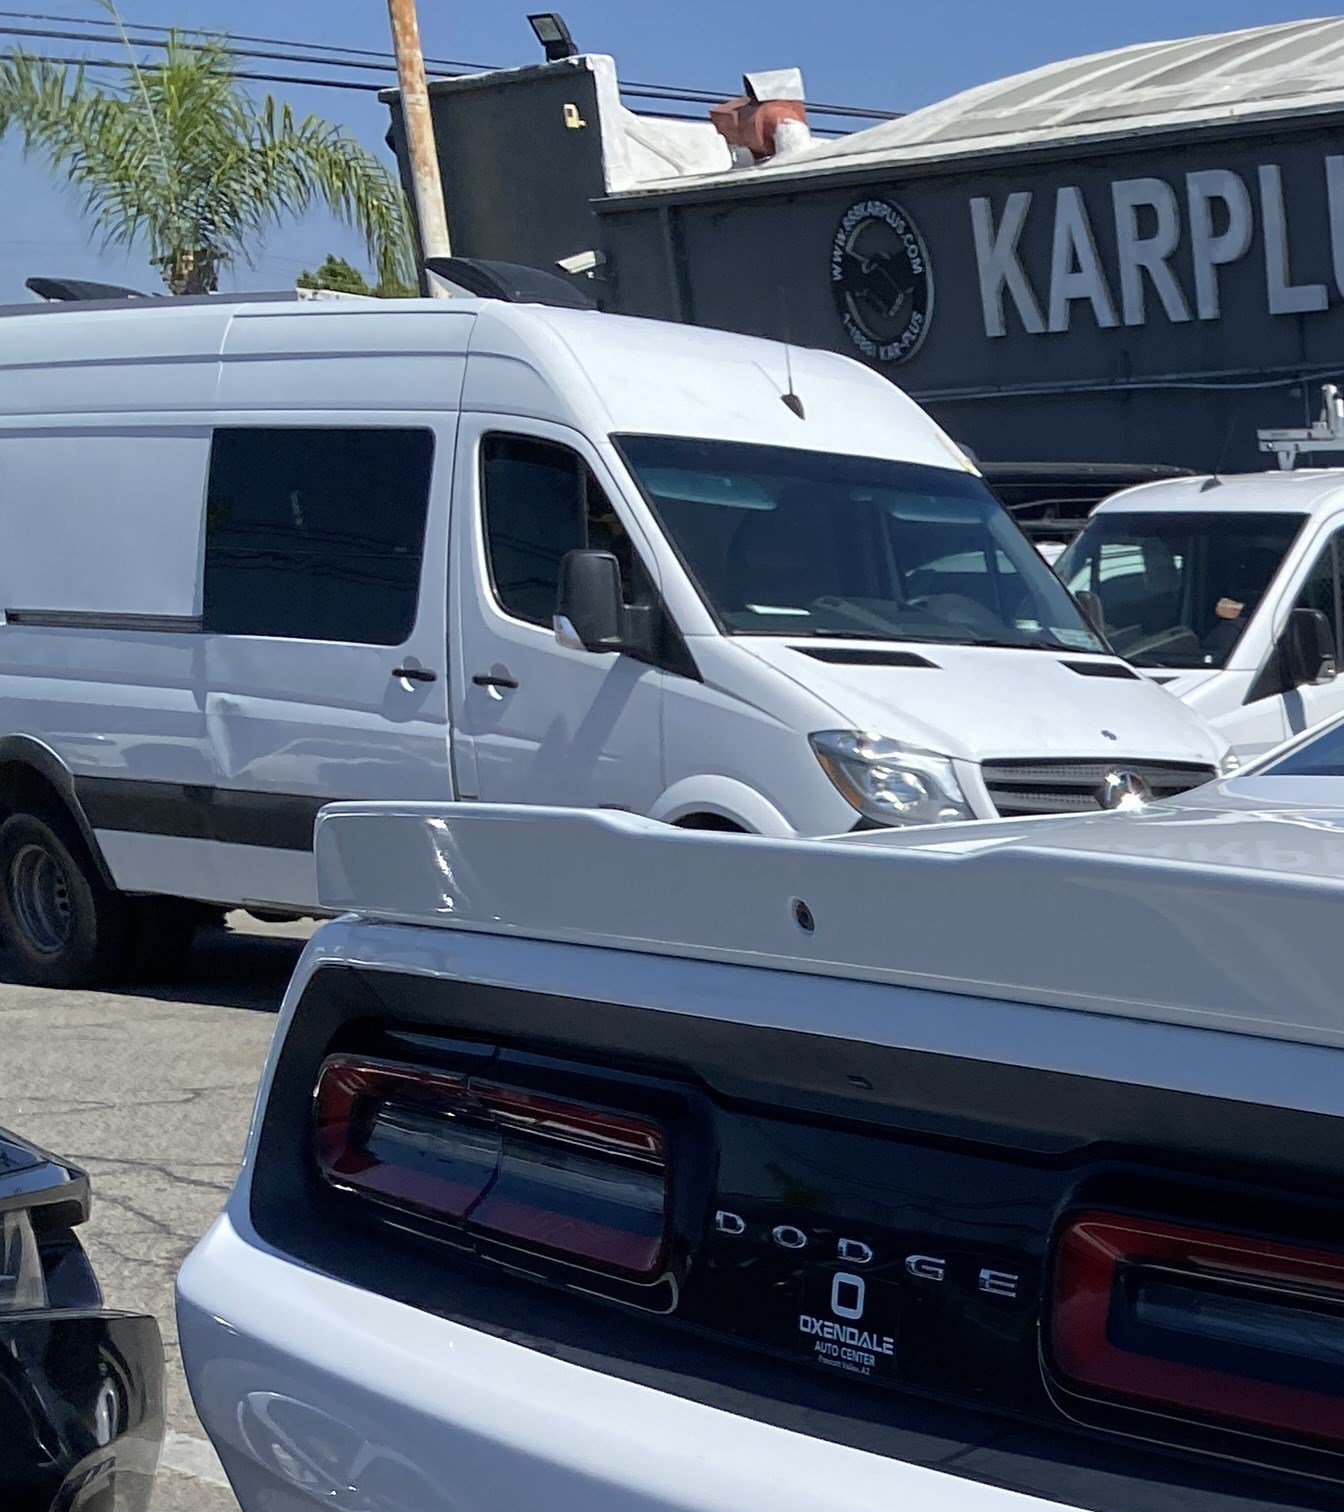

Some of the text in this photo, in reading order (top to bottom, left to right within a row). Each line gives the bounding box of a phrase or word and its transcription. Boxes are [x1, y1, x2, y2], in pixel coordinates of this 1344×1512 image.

[715, 1209, 1019, 1299] DODGE
[799, 1314, 895, 1356] OXENDALE
[814, 1340, 839, 1357] AUTO
[840, 1346, 876, 1368] CENTER
